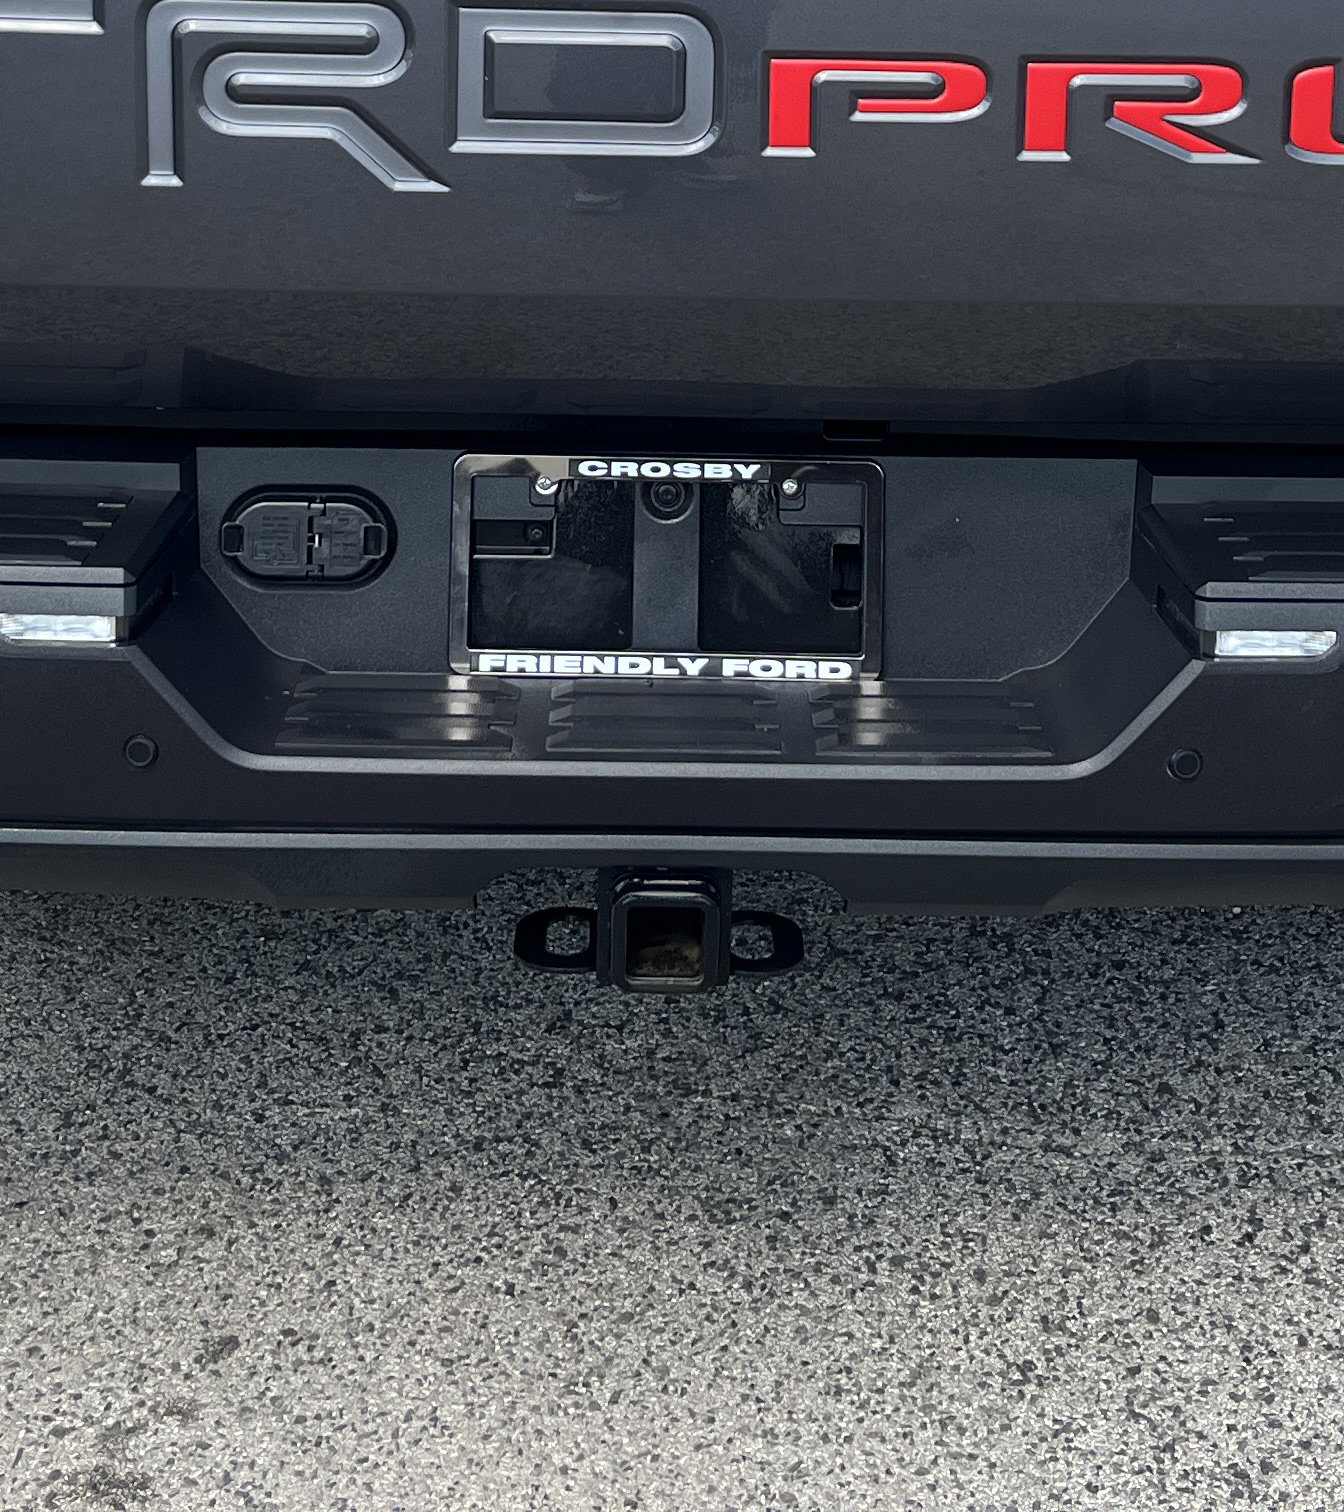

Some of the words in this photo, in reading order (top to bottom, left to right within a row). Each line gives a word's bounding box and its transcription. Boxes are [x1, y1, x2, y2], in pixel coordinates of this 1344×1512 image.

[577, 459, 762, 479] CROSBY
[478, 652, 709, 676] FRIENDLY
[722, 657, 853, 680] FORD
